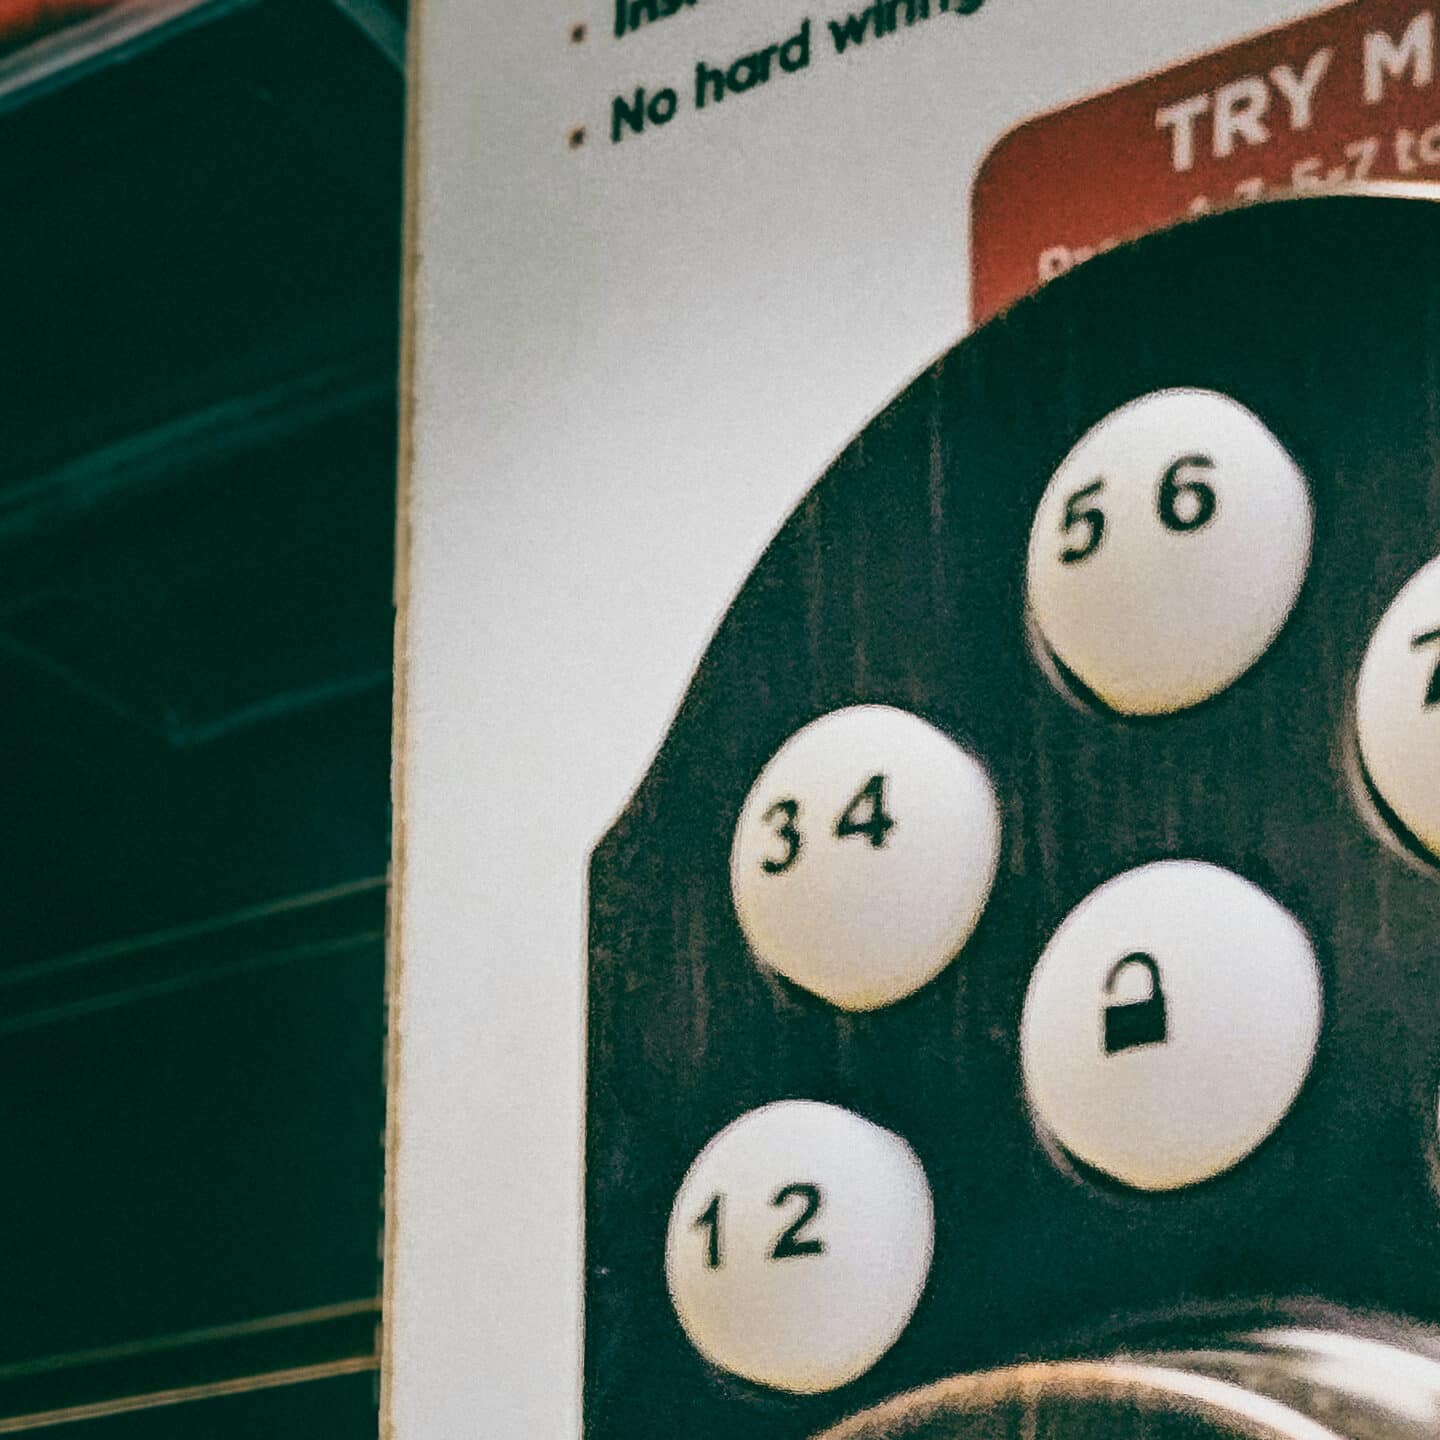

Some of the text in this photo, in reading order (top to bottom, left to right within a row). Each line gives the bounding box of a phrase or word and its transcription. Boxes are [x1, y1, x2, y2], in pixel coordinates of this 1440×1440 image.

[611, 86, 678, 144] No
[695, 18, 810, 110] hard
[1155, 47, 1336, 173] TRY
[1059, 455, 1217, 565] 5 6
[760, 774, 896, 875] 3 4
[695, 1182, 826, 1268] 1 2
